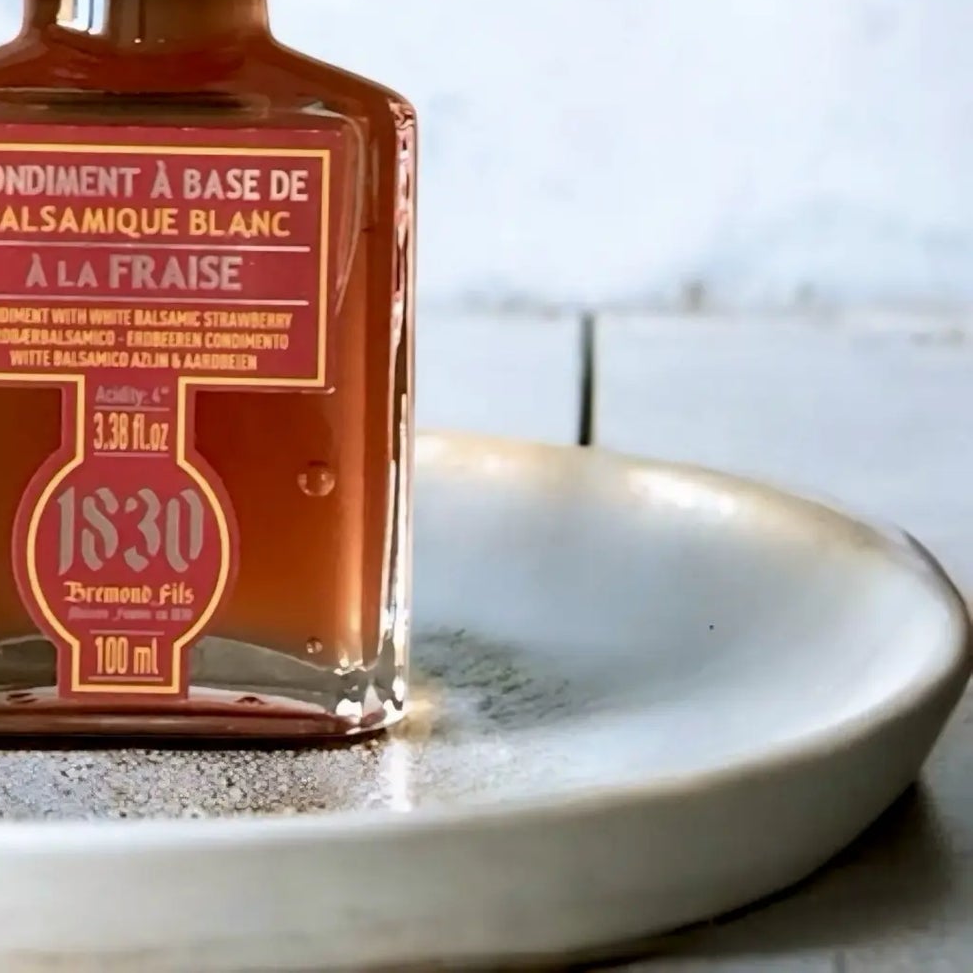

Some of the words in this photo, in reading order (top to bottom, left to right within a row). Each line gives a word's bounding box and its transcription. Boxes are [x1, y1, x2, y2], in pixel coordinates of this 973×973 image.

[150, 160, 173, 199] À
[183, 169, 260, 200] BASE
[269, 169, 309, 202] DE
[189, 209, 291, 239] BLANC
[25, 253, 48, 287] À
[58, 261, 99, 288] LA
[108, 254, 243, 291] FRAISE
[51, 307, 87, 325] WITH
[88, 308, 131, 326] WHITE
[134, 309, 201, 327] BALSAMIC
[203, 311, 293, 329] STRAWBERRY
[126, 330, 202, 348] ERDBEEREN
[204, 332, 289, 350] CONDIMENTO
[9, 349, 51, 367] WITTE
[53, 350, 129, 368] BALSAMICO
[183, 353, 258, 371] AARDBEIEN
[93, 411, 128, 450] 3.38
[56, 486, 204, 576] 1830
[63, 581, 152, 604] Bremond
[94, 636, 127, 674] 100
[133, 637, 159, 675] ml
